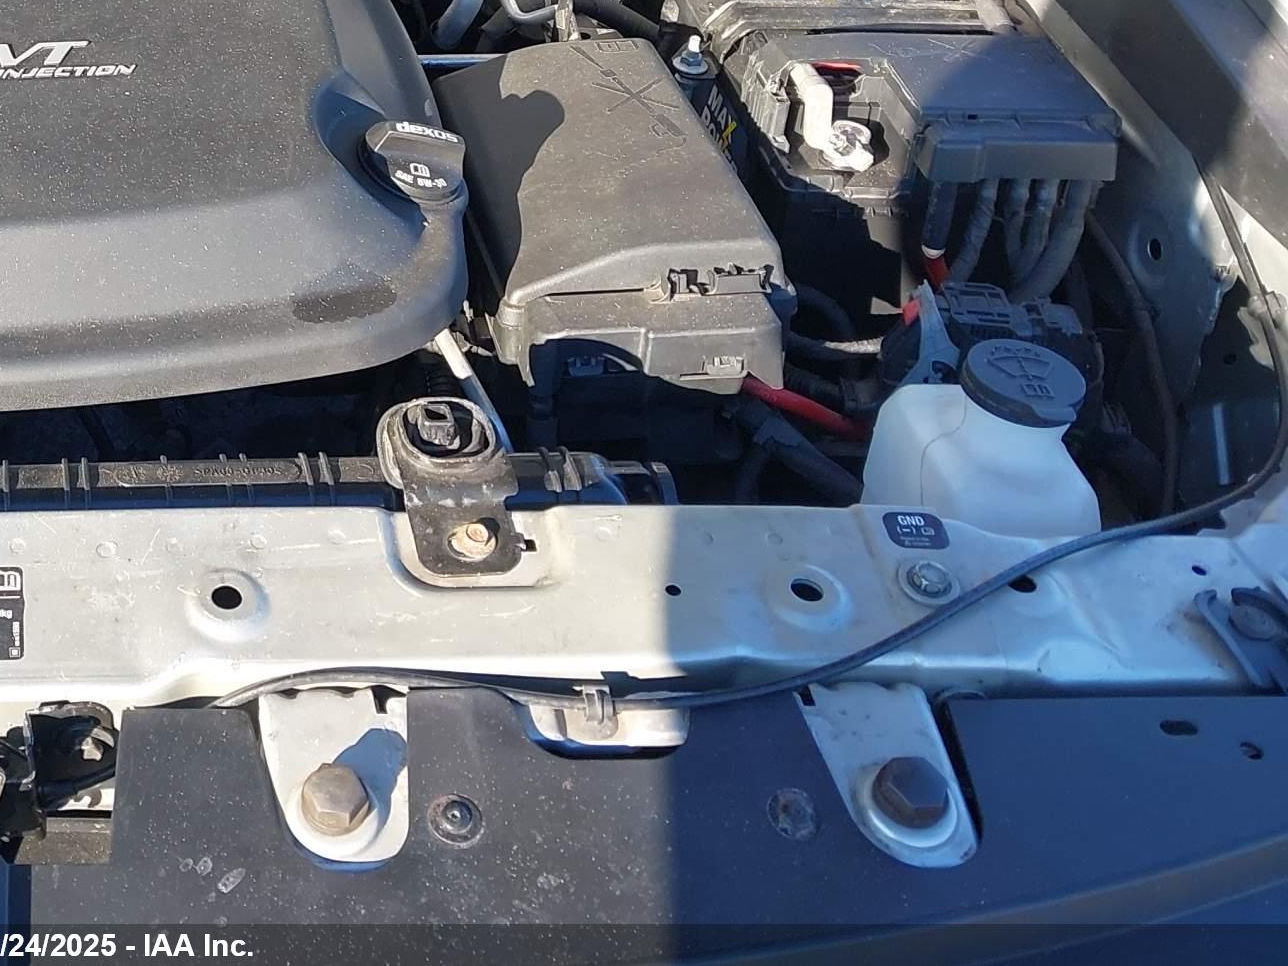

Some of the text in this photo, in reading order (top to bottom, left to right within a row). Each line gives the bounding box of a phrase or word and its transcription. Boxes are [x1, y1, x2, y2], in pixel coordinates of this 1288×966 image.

[396, 122, 458, 143] dexos
[395, 170, 414, 184] SAE
[897, 515, 925, 527] GND
